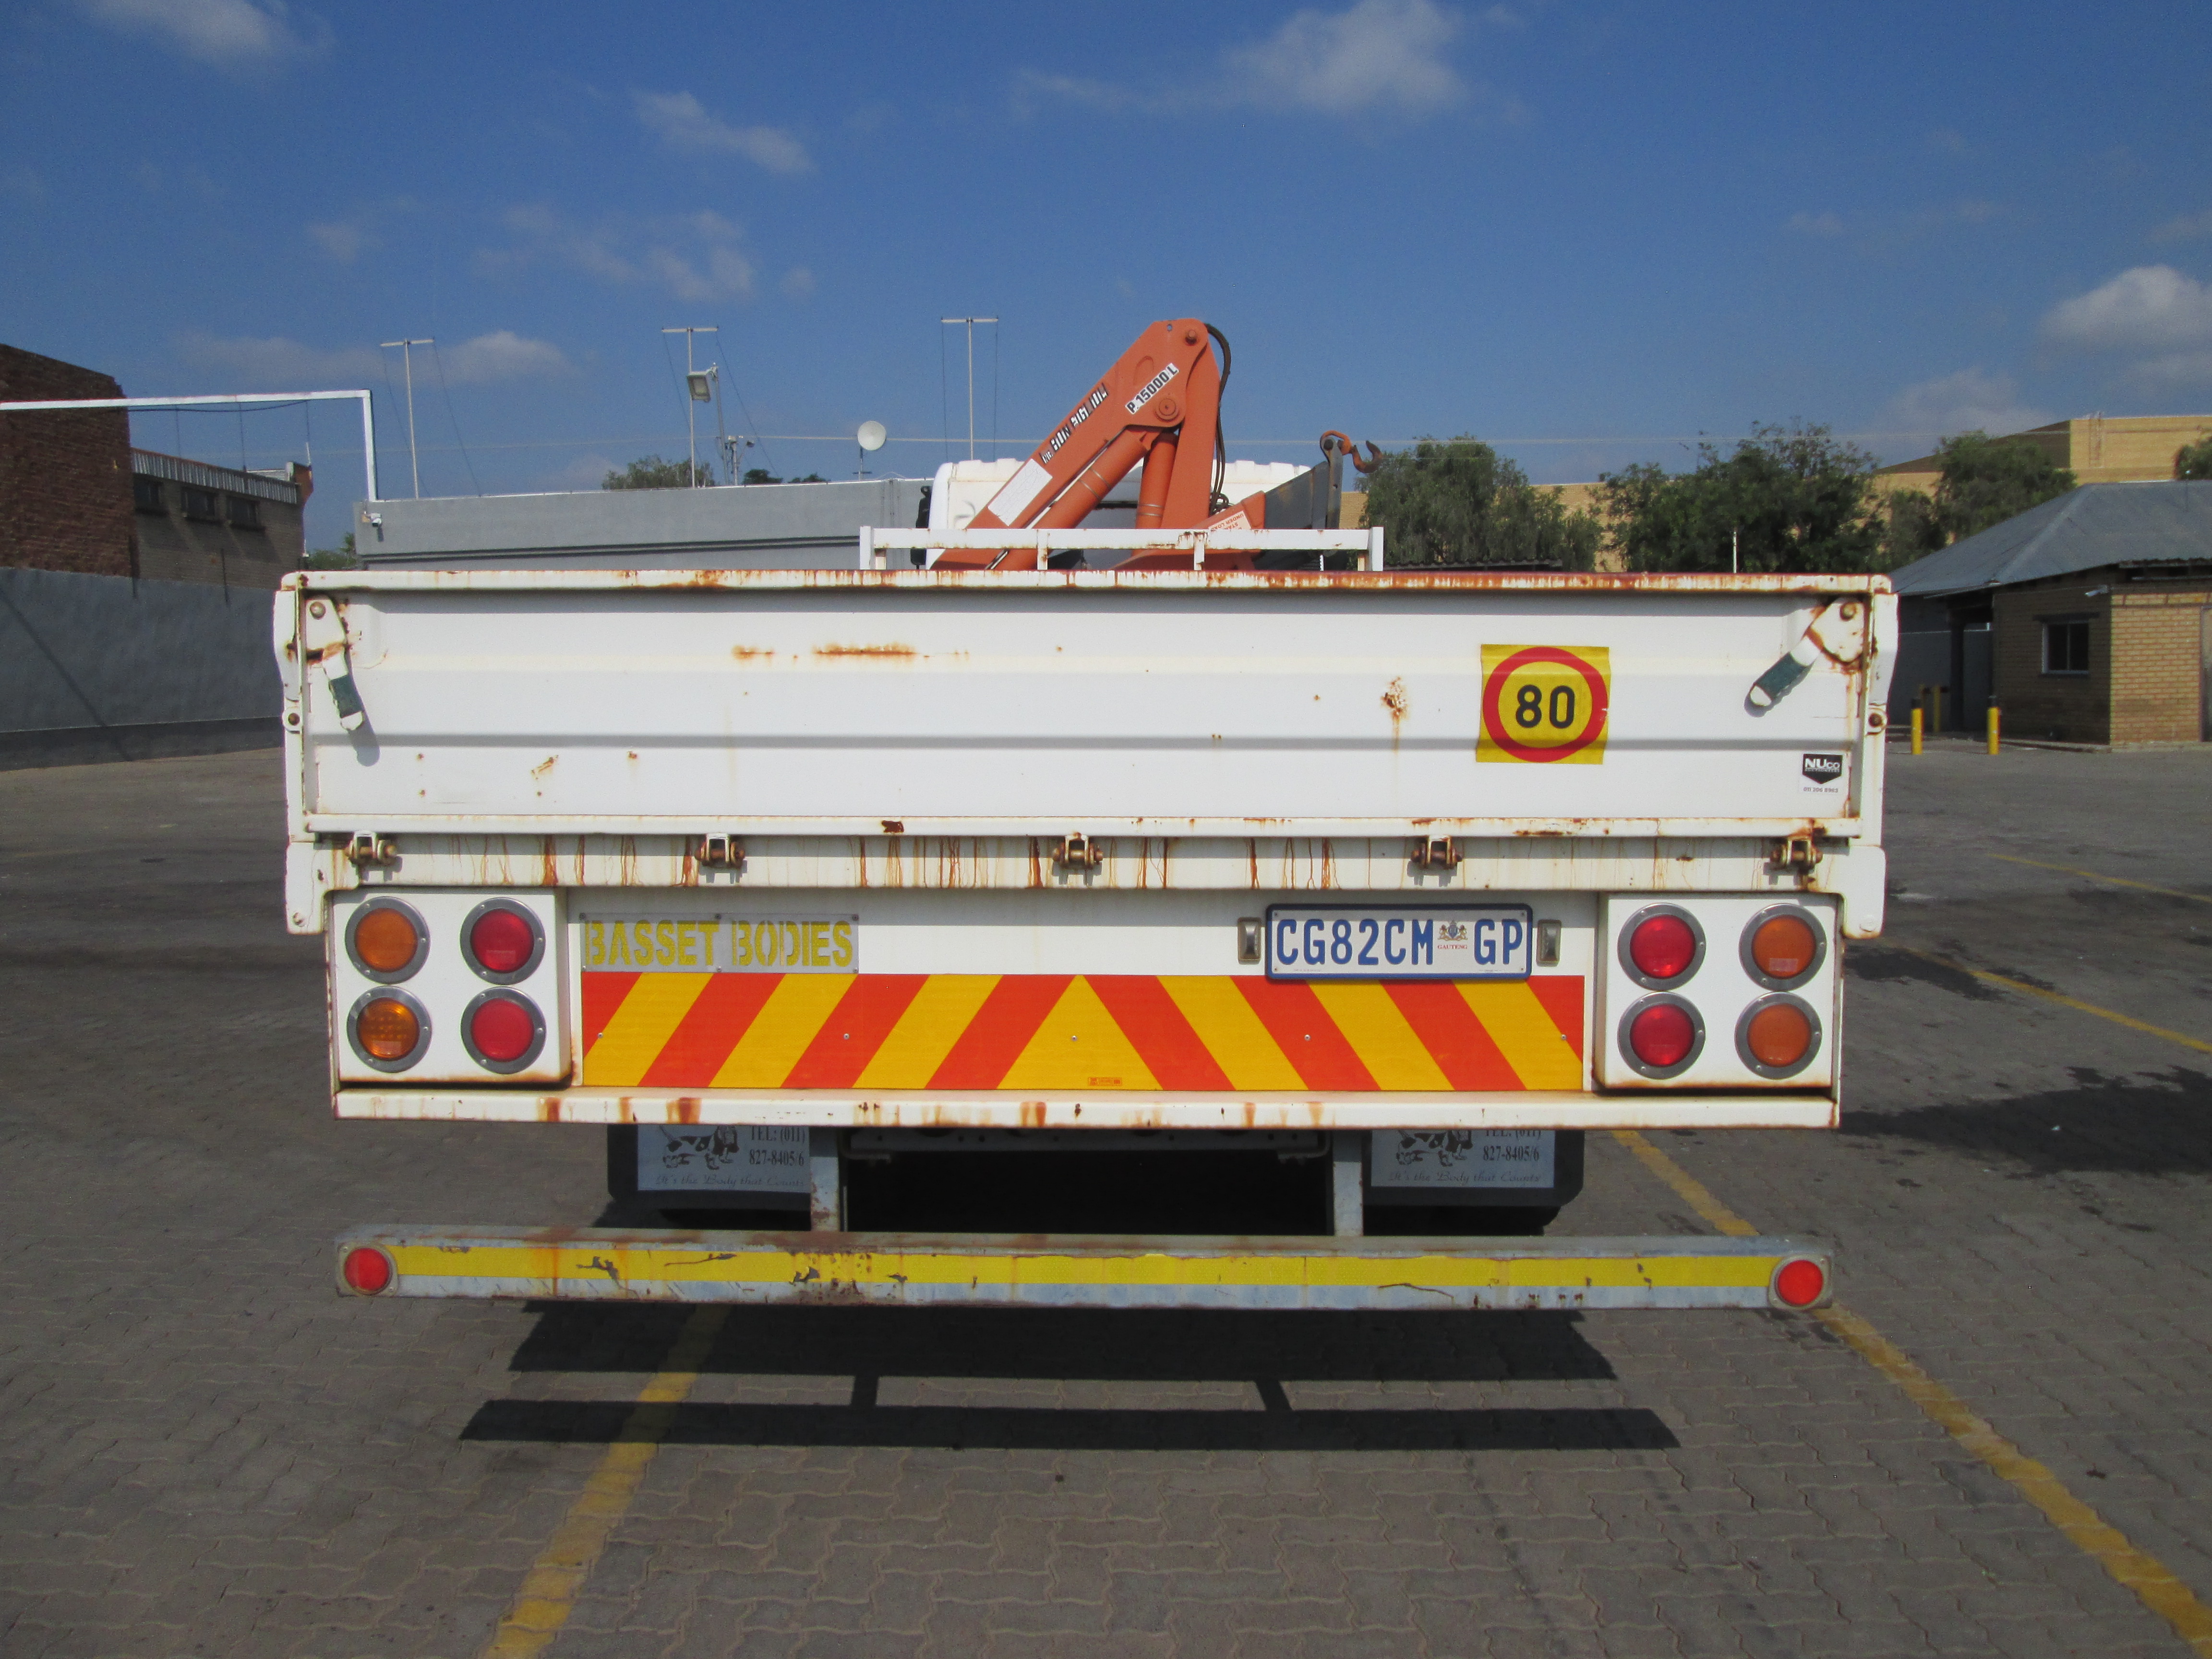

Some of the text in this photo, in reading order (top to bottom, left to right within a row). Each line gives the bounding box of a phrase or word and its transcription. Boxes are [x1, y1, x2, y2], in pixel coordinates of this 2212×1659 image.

[1135, 371, 1169, 404] 15000
[1166, 366, 1178, 375] L
[1226, 513, 1244, 525] UNDER
[1515, 684, 1575, 728] 80
[584, 920, 853, 967] BASSET BODIES
[1277, 919, 1523, 965] CG82CM GP
[681, 1174, 698, 1185] the
[704, 1174, 736, 1187] Body
[739, 1174, 762, 1186] that
[1414, 1171, 1430, 1181] the
[1437, 1171, 1469, 1183] Body
[1474, 1171, 1496, 1182] that
